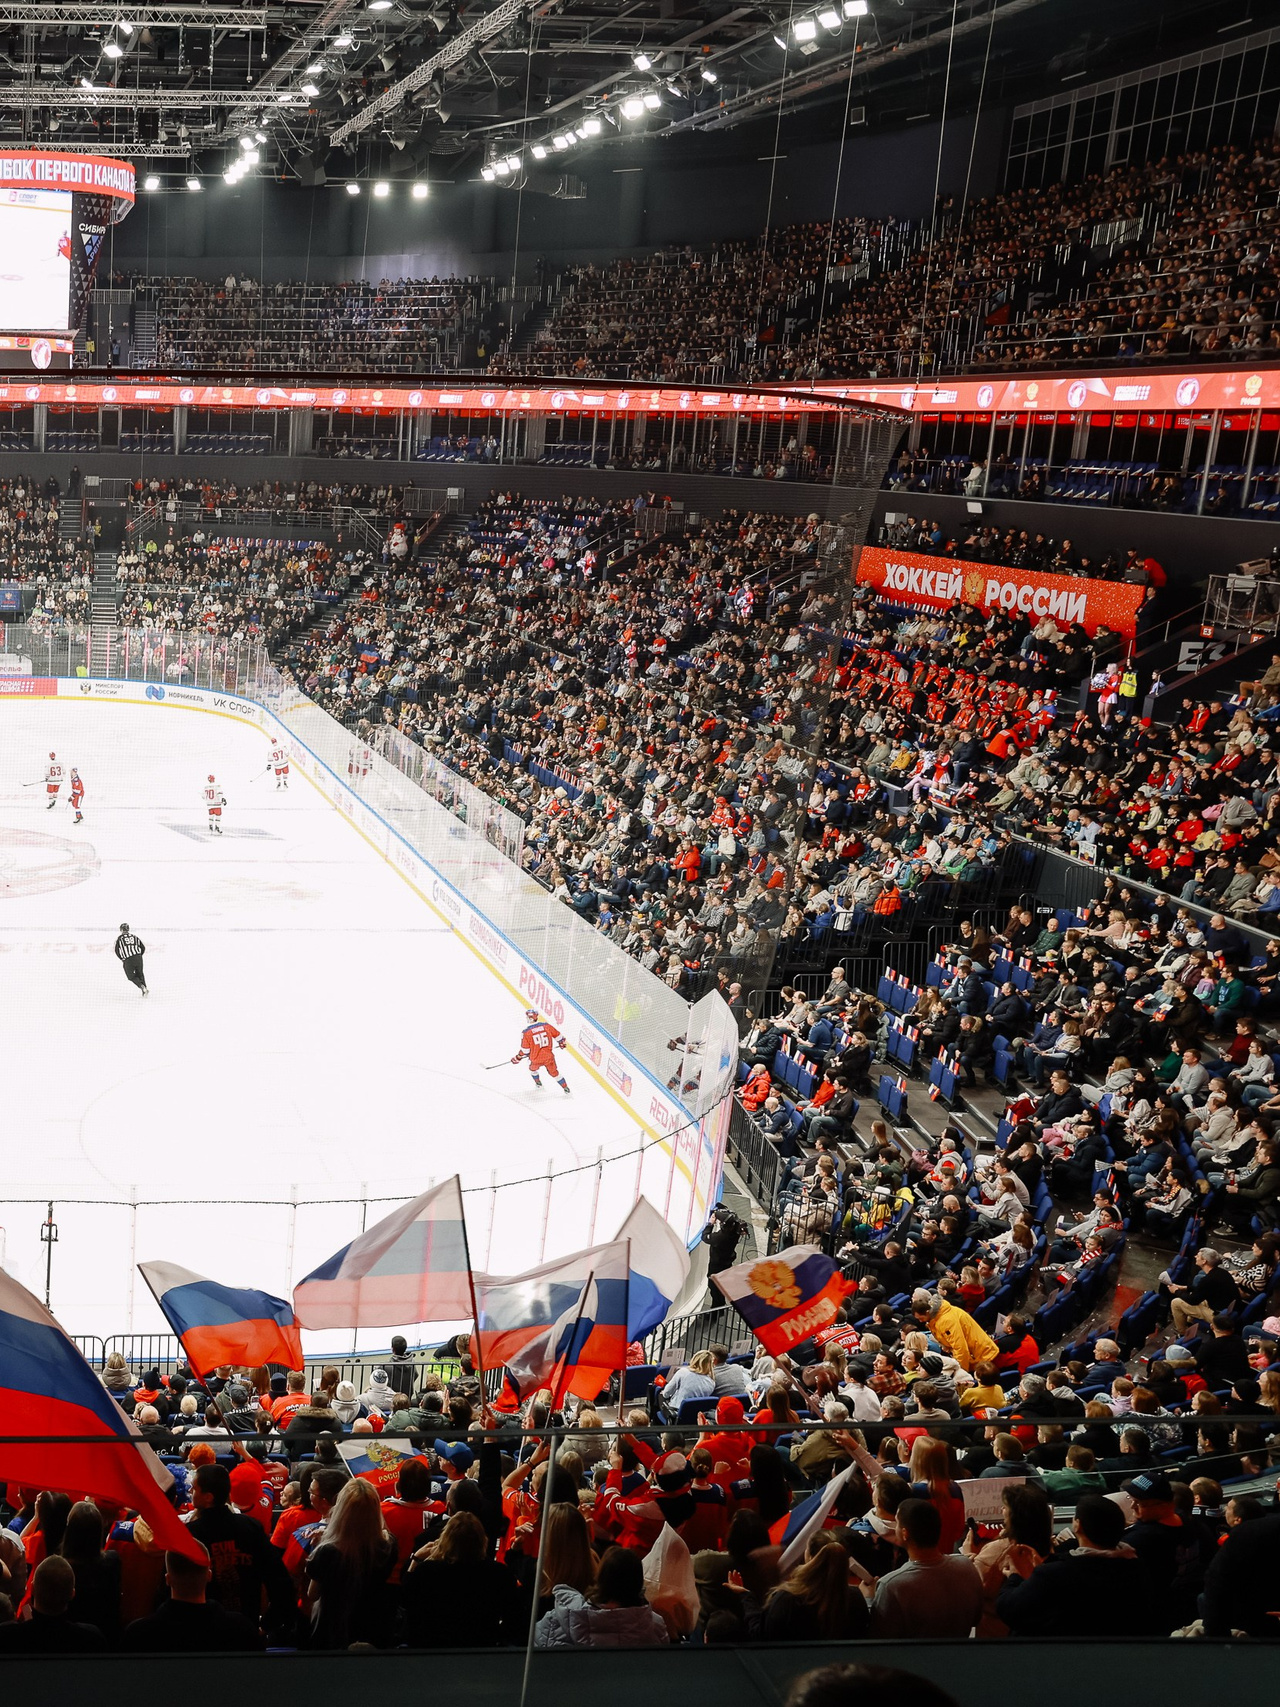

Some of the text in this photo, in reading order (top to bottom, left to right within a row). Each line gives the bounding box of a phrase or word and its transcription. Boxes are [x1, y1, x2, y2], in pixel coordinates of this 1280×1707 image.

[36, 159, 92, 184] ПЕРВОГО
[882, 562, 1088, 624] ХОККЕЙ РОССИИ
[214, 698, 256, 718] VK СПОРТ
[273, 750, 284, 761] 97
[50, 766, 62, 776] 63
[520, 964, 564, 1025] РОЛЬФ
[532, 1032, 548, 1048] 96
[650, 1096, 668, 1128] RED
[780, 1296, 838, 1342] РОССИЯ
[211, 1540, 238, 1554] EVIL
